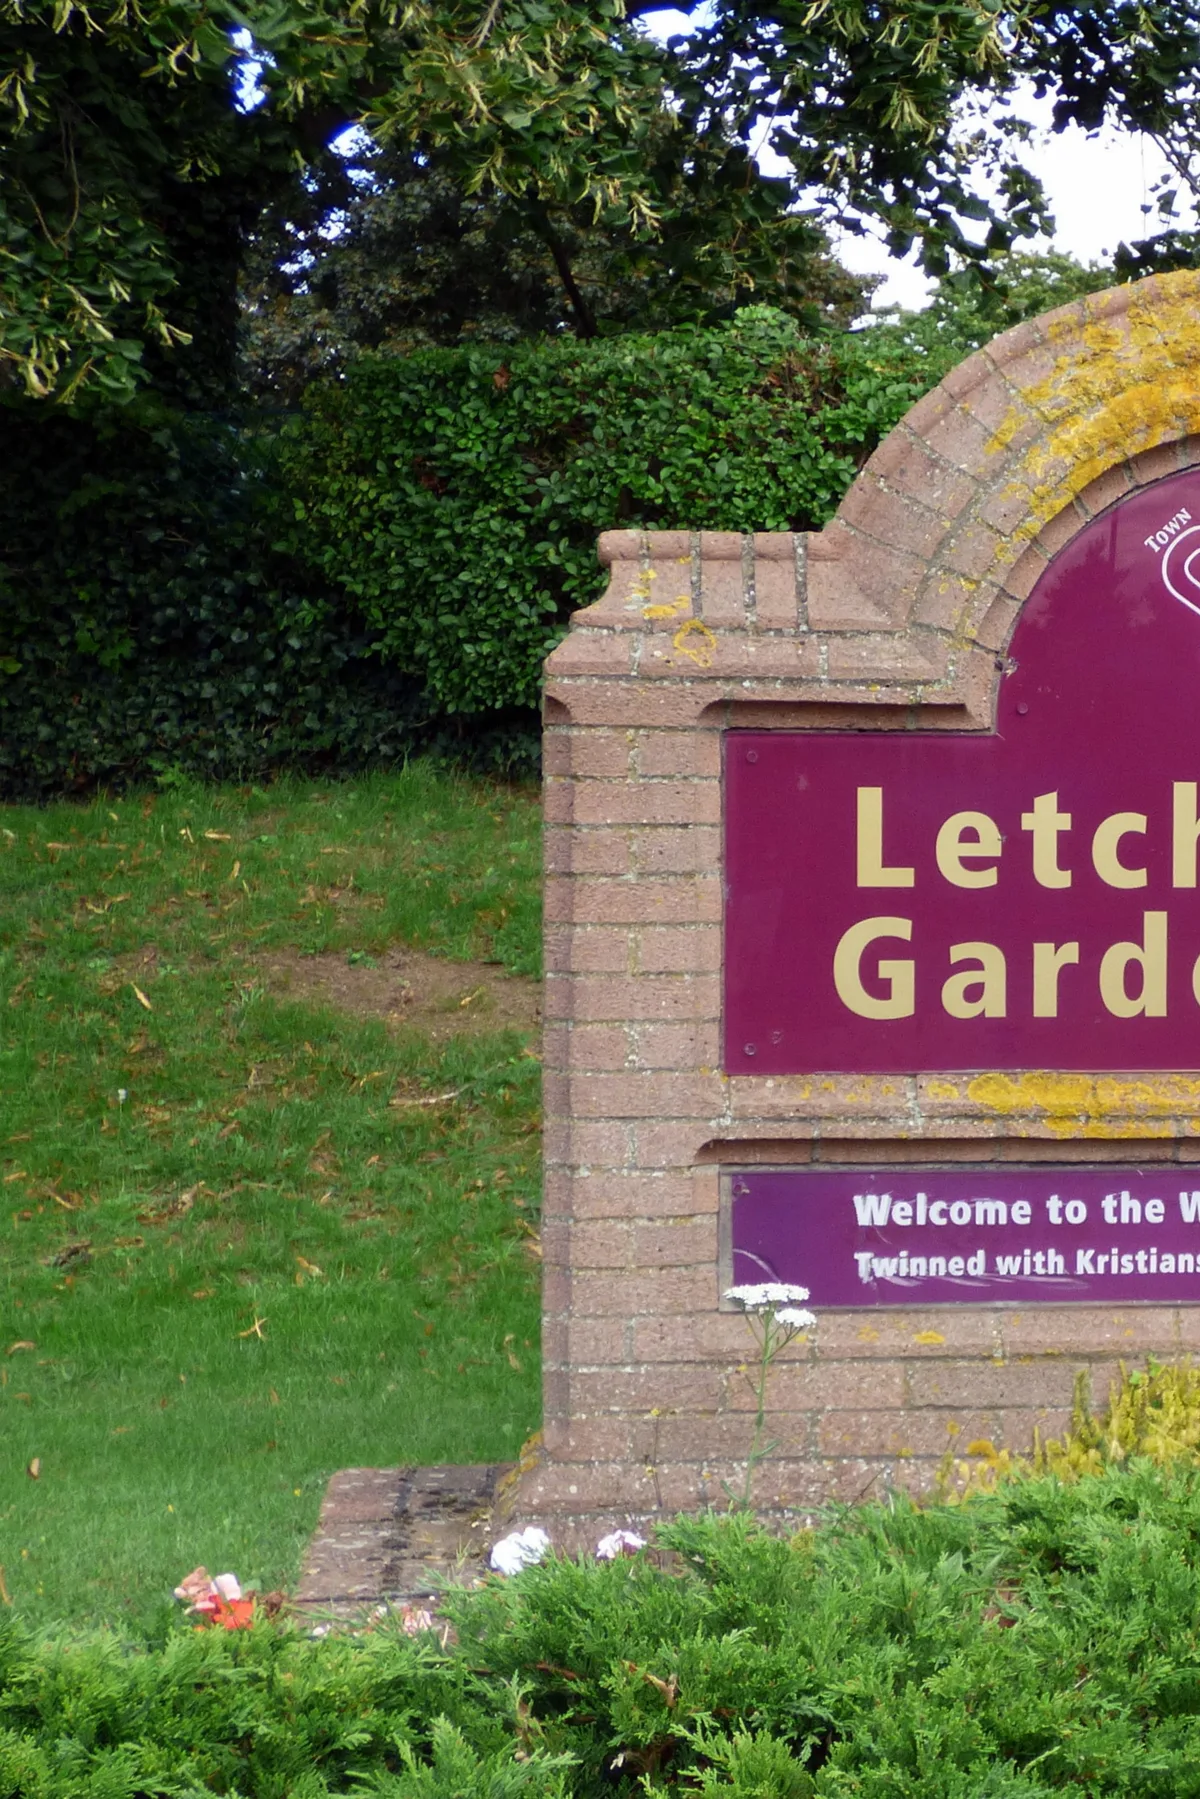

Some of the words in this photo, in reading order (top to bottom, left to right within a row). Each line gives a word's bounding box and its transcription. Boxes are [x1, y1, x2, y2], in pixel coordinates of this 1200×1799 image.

[853, 1192, 1031, 1226] Welcome
[1046, 1194, 1087, 1225] to
[1102, 1191, 1165, 1223] the
[854, 1250, 985, 1278] Twinned
[996, 1249, 1064, 1276] with
